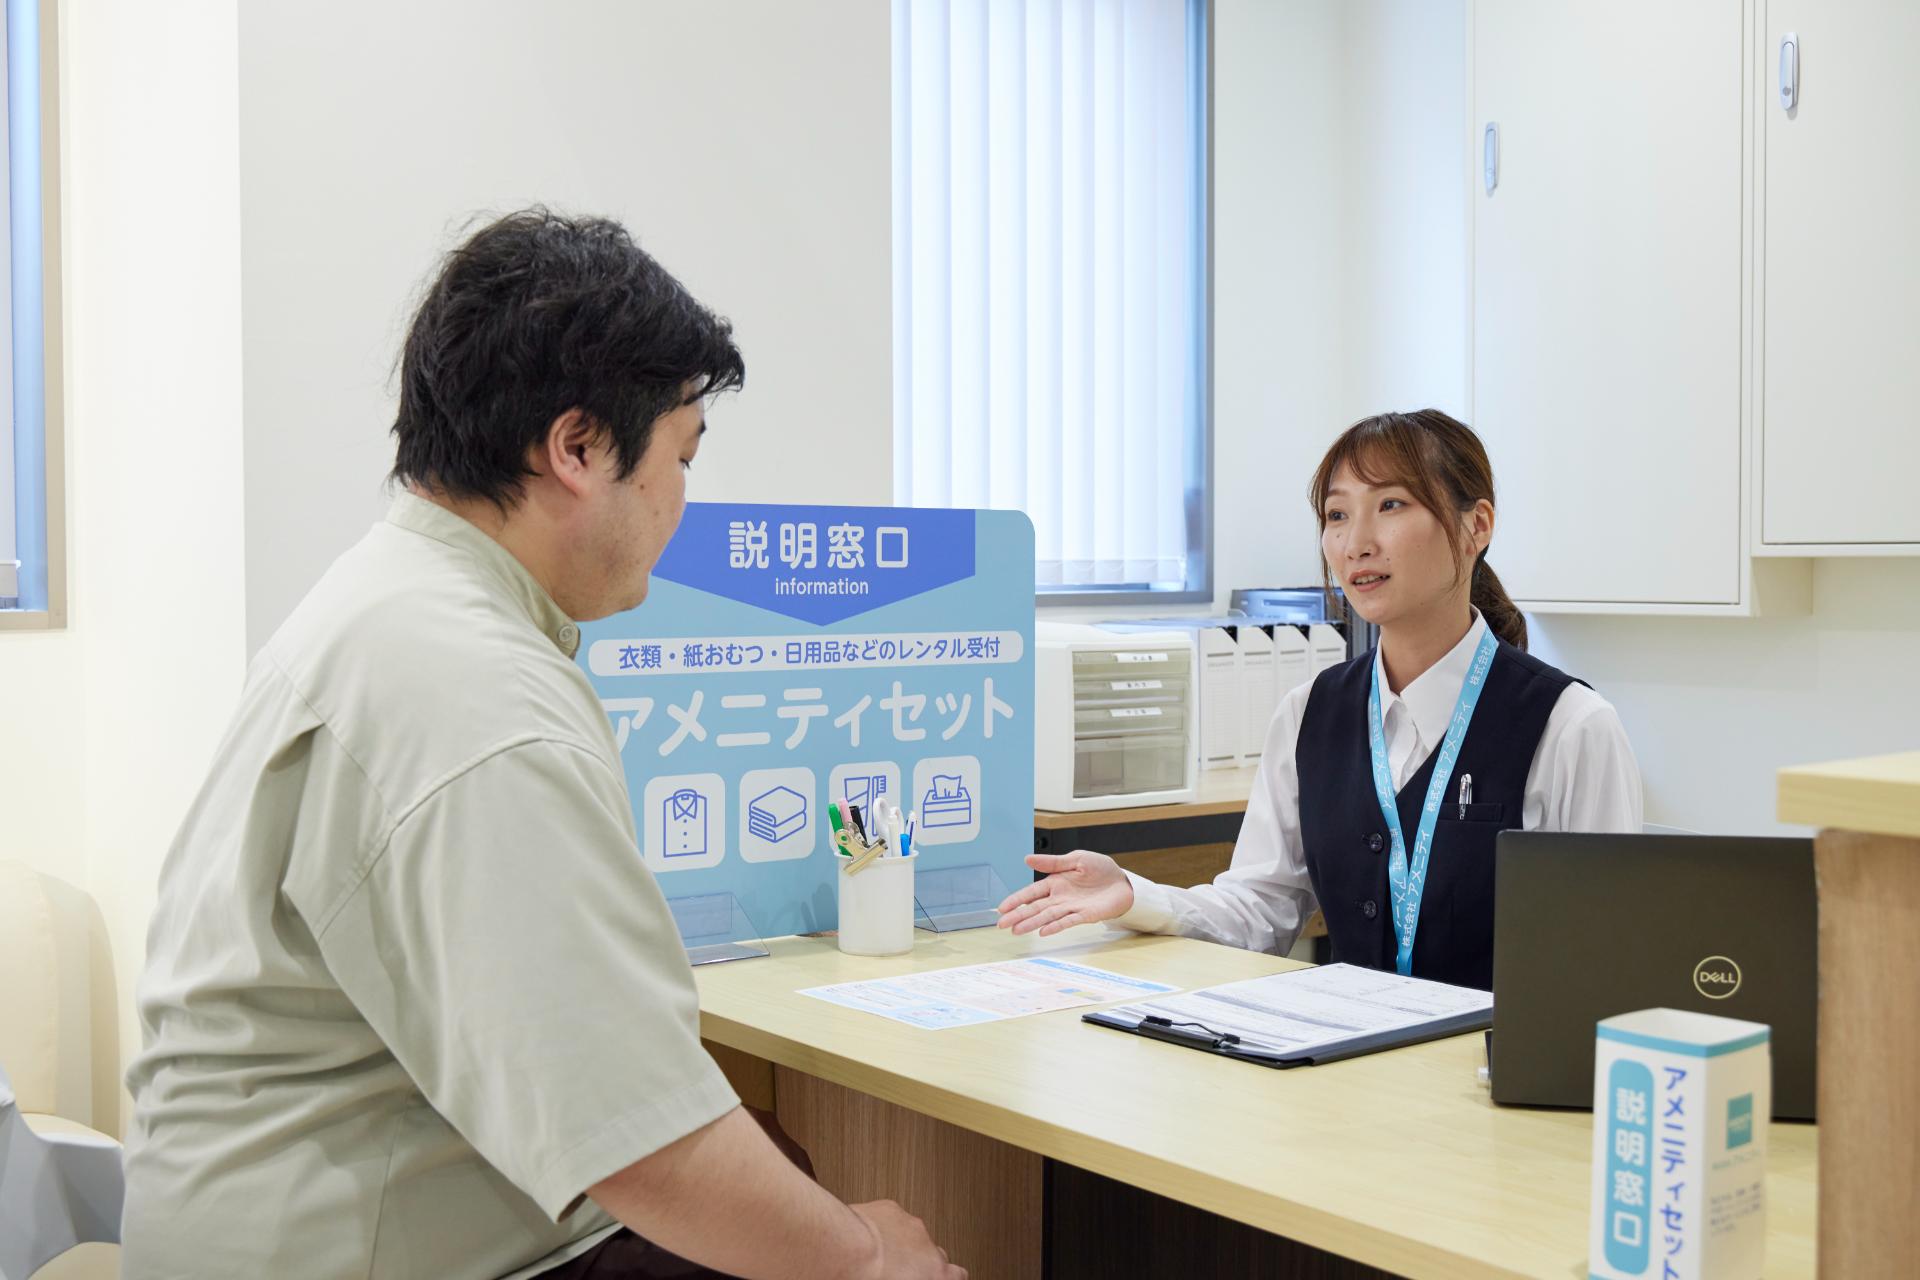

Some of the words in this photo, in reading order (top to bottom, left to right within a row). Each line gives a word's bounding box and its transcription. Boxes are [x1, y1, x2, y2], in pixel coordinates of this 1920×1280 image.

[729, 520, 908, 569] 説明窓口
[775, 577, 869, 595] information
[619, 636, 1001, 670] 衣類・紙おむつ・日用品などのレンタル受付
[599, 677, 1014, 757] アメニティセット
[1439, 699, 1472, 765] アメニティ
[1426, 766, 1448, 812] 株式会社
[1407, 829, 1430, 898] アメニティ
[1402, 901, 1418, 948] 株式会社
[1700, 971, 1736, 984] DELL
[1613, 1087, 1647, 1248] 説明窓口
[1659, 1066, 1687, 1280] アメニティセット
